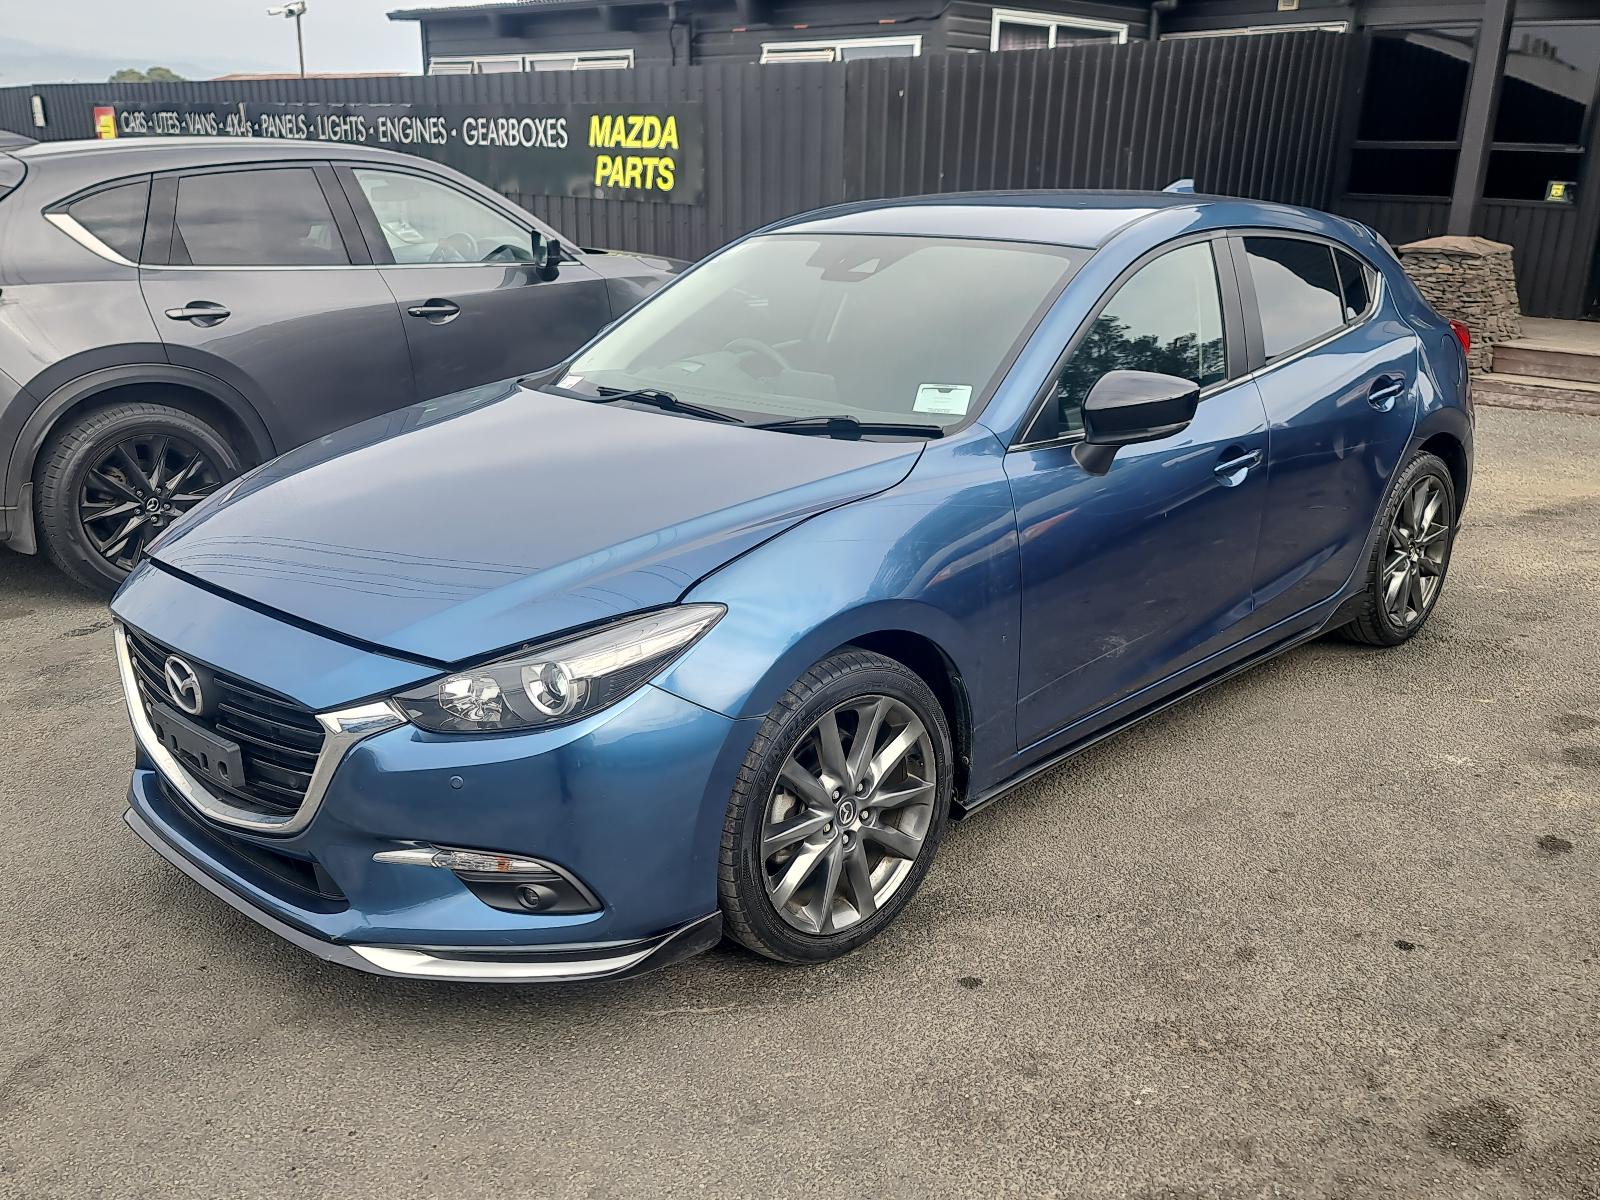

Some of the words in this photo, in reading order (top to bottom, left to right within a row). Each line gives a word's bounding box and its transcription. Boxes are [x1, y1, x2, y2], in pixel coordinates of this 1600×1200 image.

[120, 110, 147, 133] CARS
[152, 111, 181, 134] UTES
[184, 112, 218, 136] VANS
[260, 113, 307, 140] PANELS
[316, 115, 367, 142] LIGHTS
[377, 116, 448, 145] ENGINES
[462, 117, 569, 148] GEARBOXES
[588, 114, 679, 150] MAZDA
[594, 154, 676, 192] PARTS
